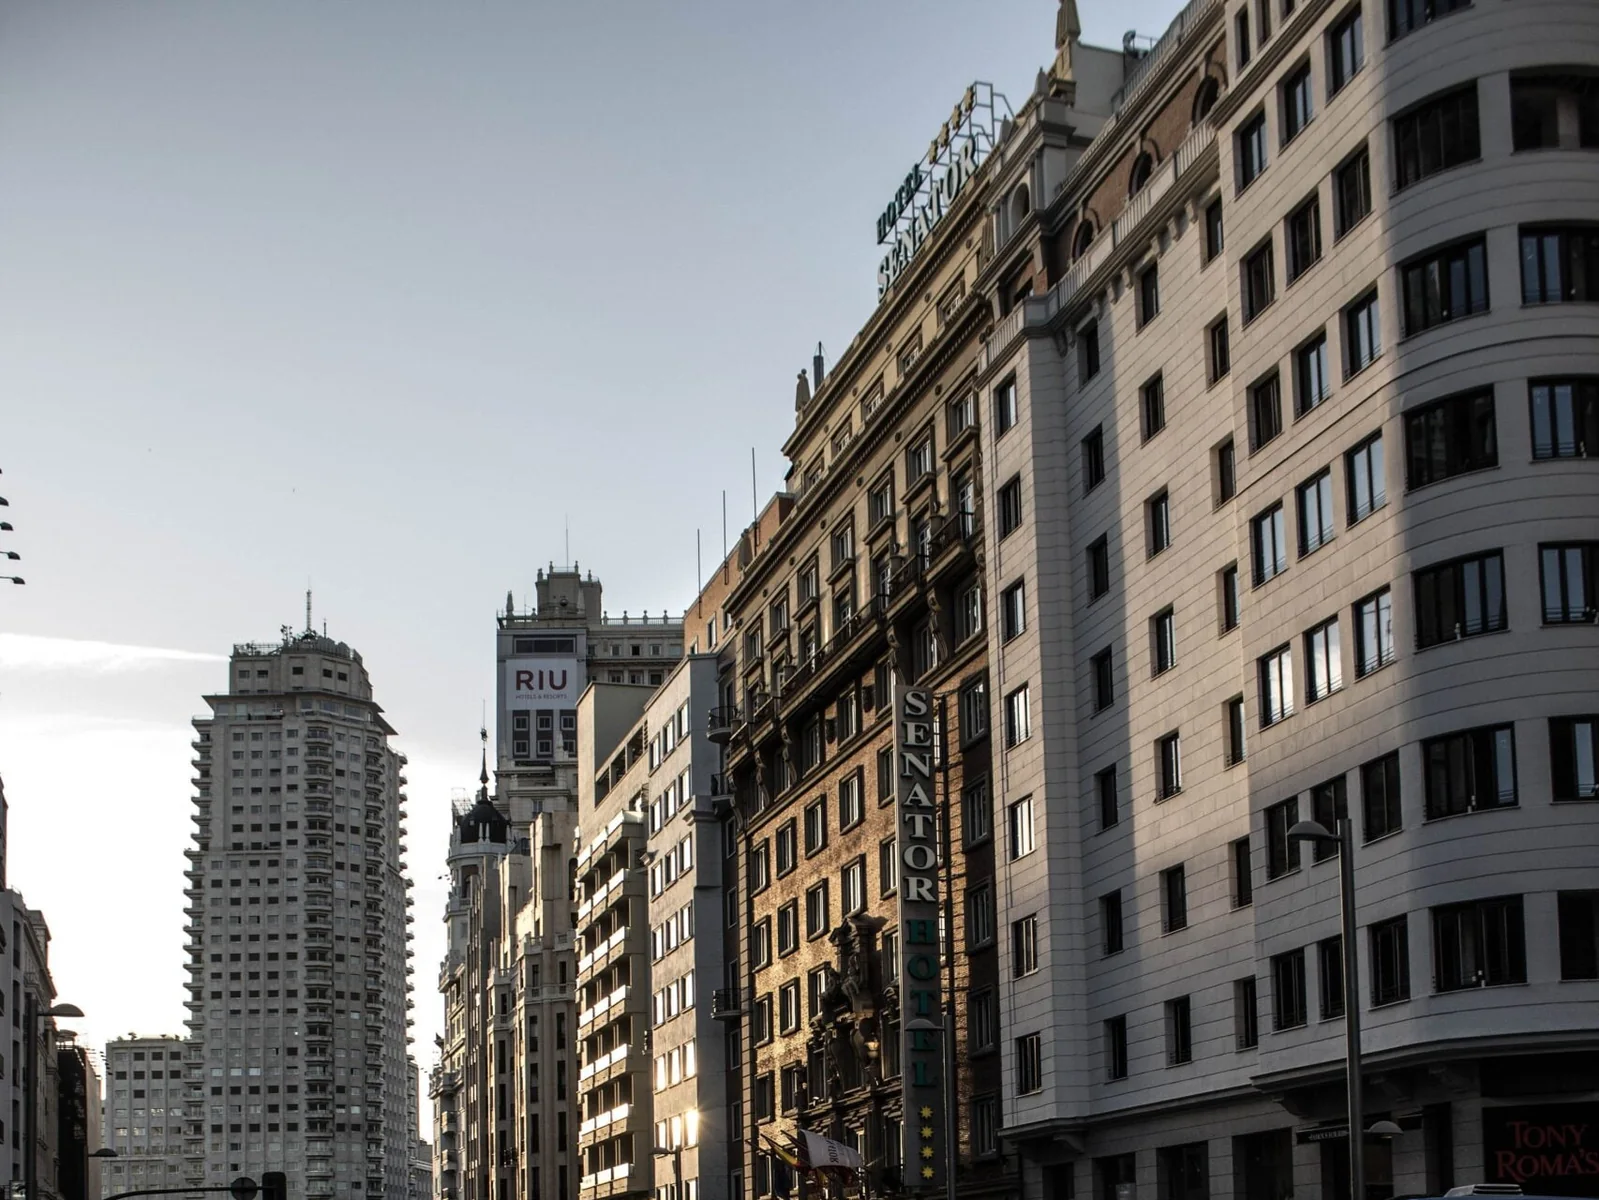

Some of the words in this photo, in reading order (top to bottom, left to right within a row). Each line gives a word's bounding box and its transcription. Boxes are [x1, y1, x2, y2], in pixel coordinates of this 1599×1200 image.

[876, 163, 922, 245] HOTEL
[877, 135, 977, 302] SENATOR
[516, 669, 567, 691] RIU
[902, 690, 936, 903] SENATOR
[906, 919, 937, 1087] HOTEL
[1494, 1148, 1599, 1183] ROMA'S
[1506, 1119, 1590, 1149] TONY
